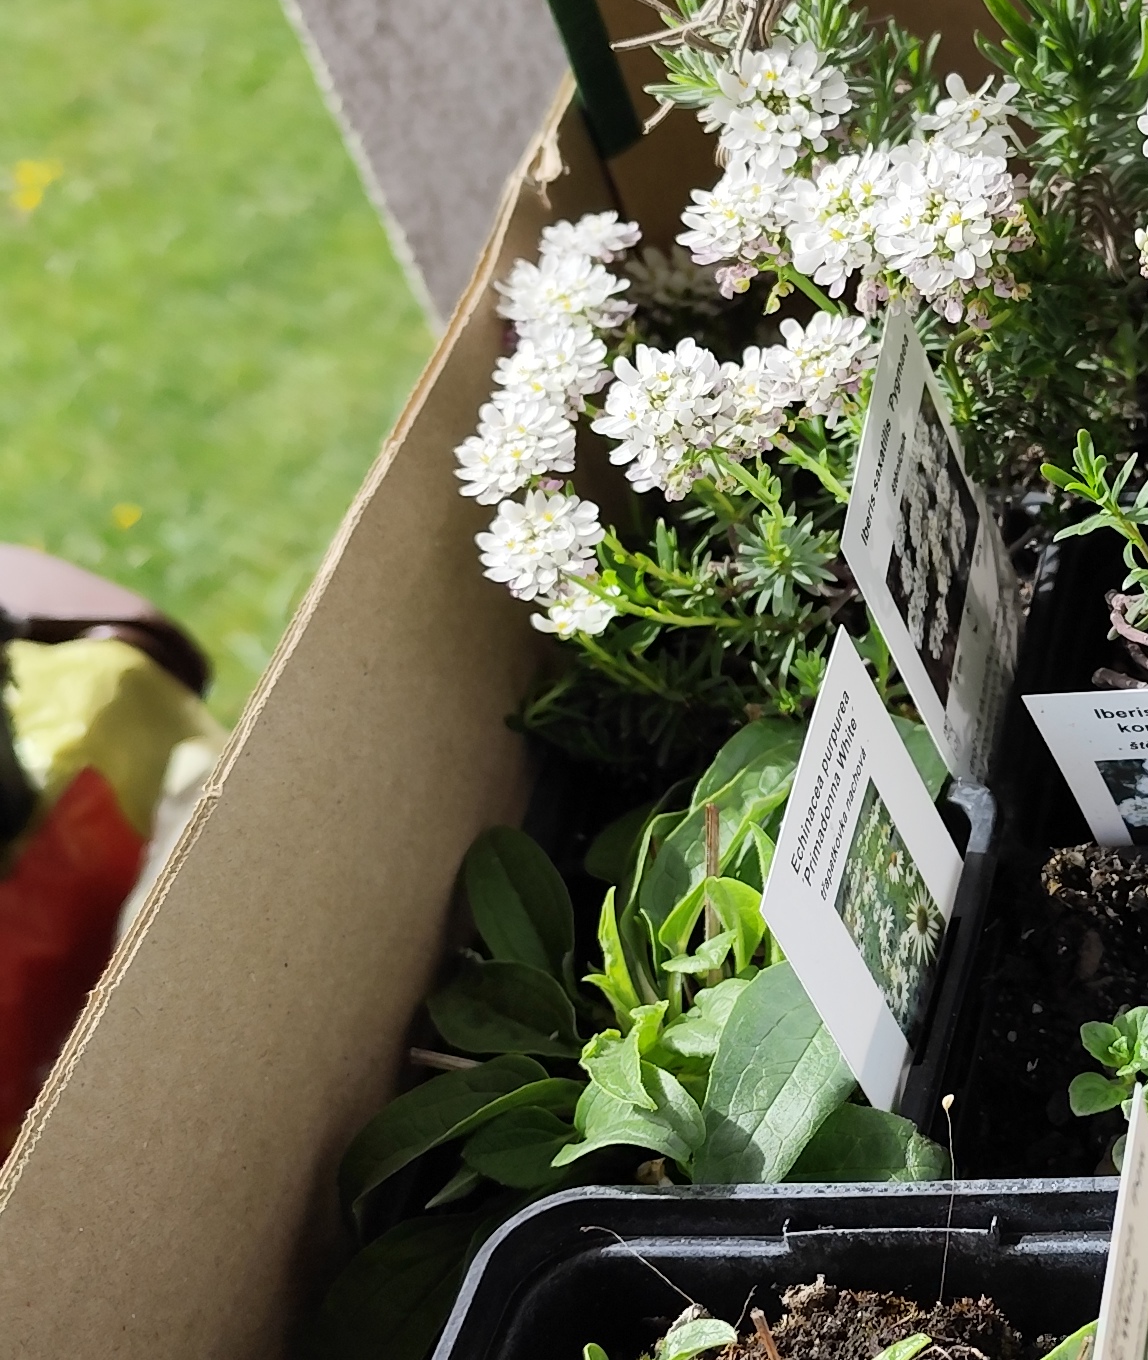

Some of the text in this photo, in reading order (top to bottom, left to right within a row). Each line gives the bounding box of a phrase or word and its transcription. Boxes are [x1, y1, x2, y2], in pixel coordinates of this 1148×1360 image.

[861, 493, 876, 547] Iberis
[874, 418, 891, 492] saxatilis
[790, 690, 850, 876] Echinacea purpurea
